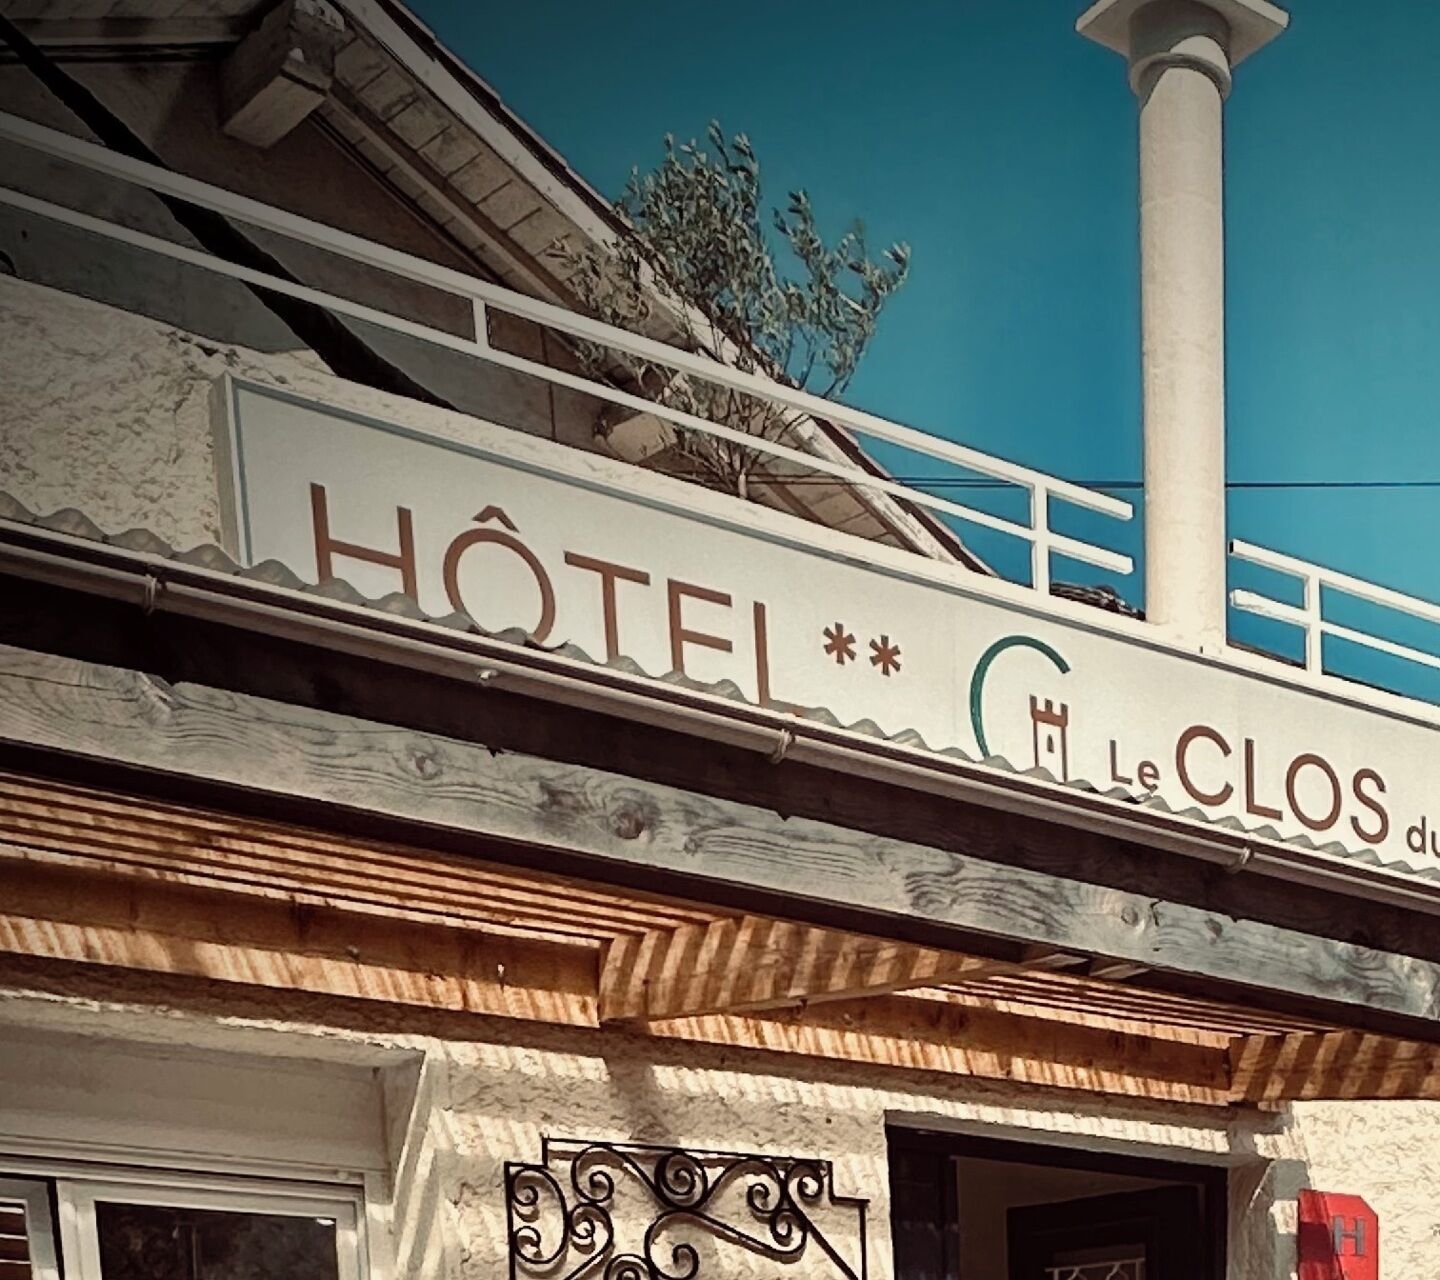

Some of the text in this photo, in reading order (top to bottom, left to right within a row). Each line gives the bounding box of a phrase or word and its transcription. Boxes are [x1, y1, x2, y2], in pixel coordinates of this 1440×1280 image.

[1109, 739, 1160, 790] Le
[1175, 725, 1390, 844] CLOS
[1332, 1215, 1367, 1257] H
